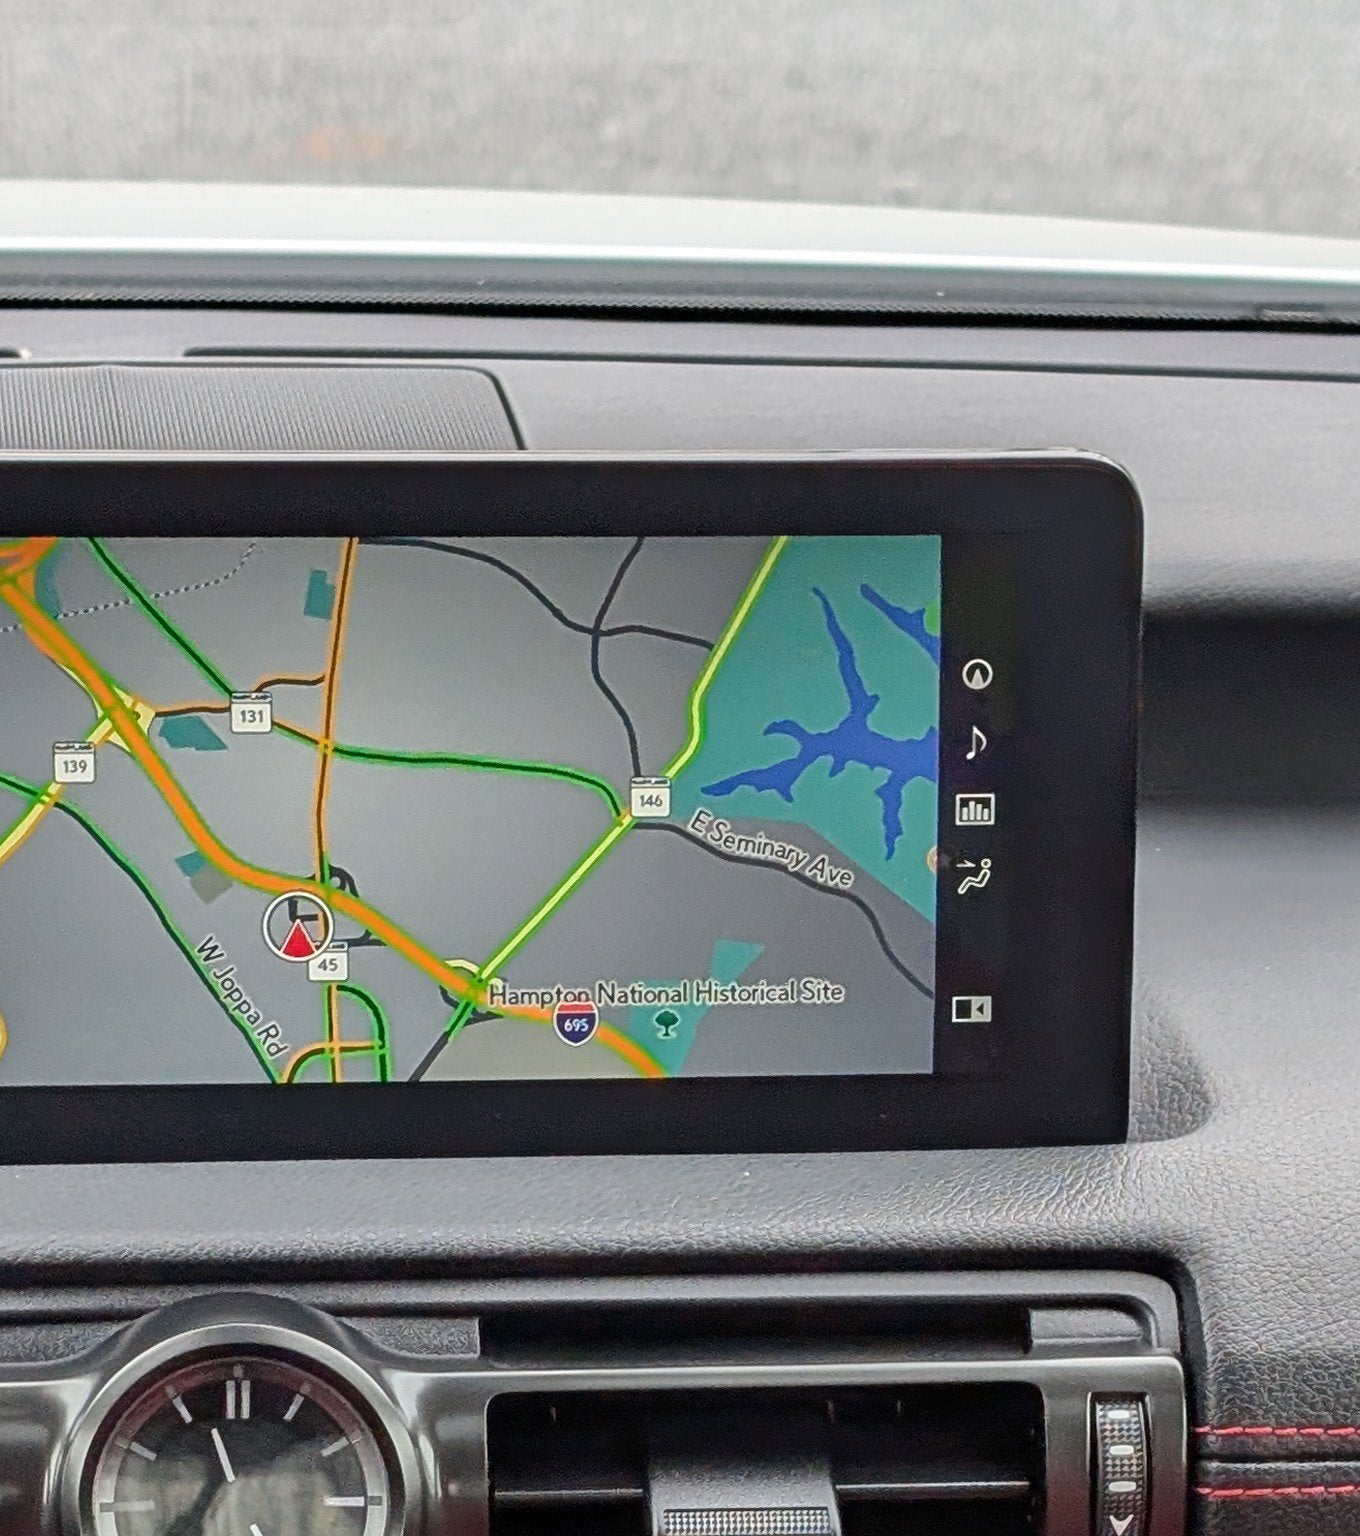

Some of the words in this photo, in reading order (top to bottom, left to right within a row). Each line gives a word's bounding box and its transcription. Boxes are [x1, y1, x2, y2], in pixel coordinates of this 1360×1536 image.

[240, 709, 264, 723] 131
[62, 759, 88, 774] 139
[640, 794, 663, 808] 146
[690, 809, 712, 833] E
[709, 820, 808, 869] Seminary
[808, 857, 853, 887] Ave
[317, 958, 339, 972] 45
[196, 935, 225, 963] W
[212, 966, 261, 1026] Joppa
[257, 1023, 289, 1058] Rd
[489, 985, 590, 1008] Hampton
[597, 981, 689, 1004] National
[694, 980, 797, 1003] Historical
[800, 980, 844, 1002] Site
[563, 1018, 590, 1033] 695
